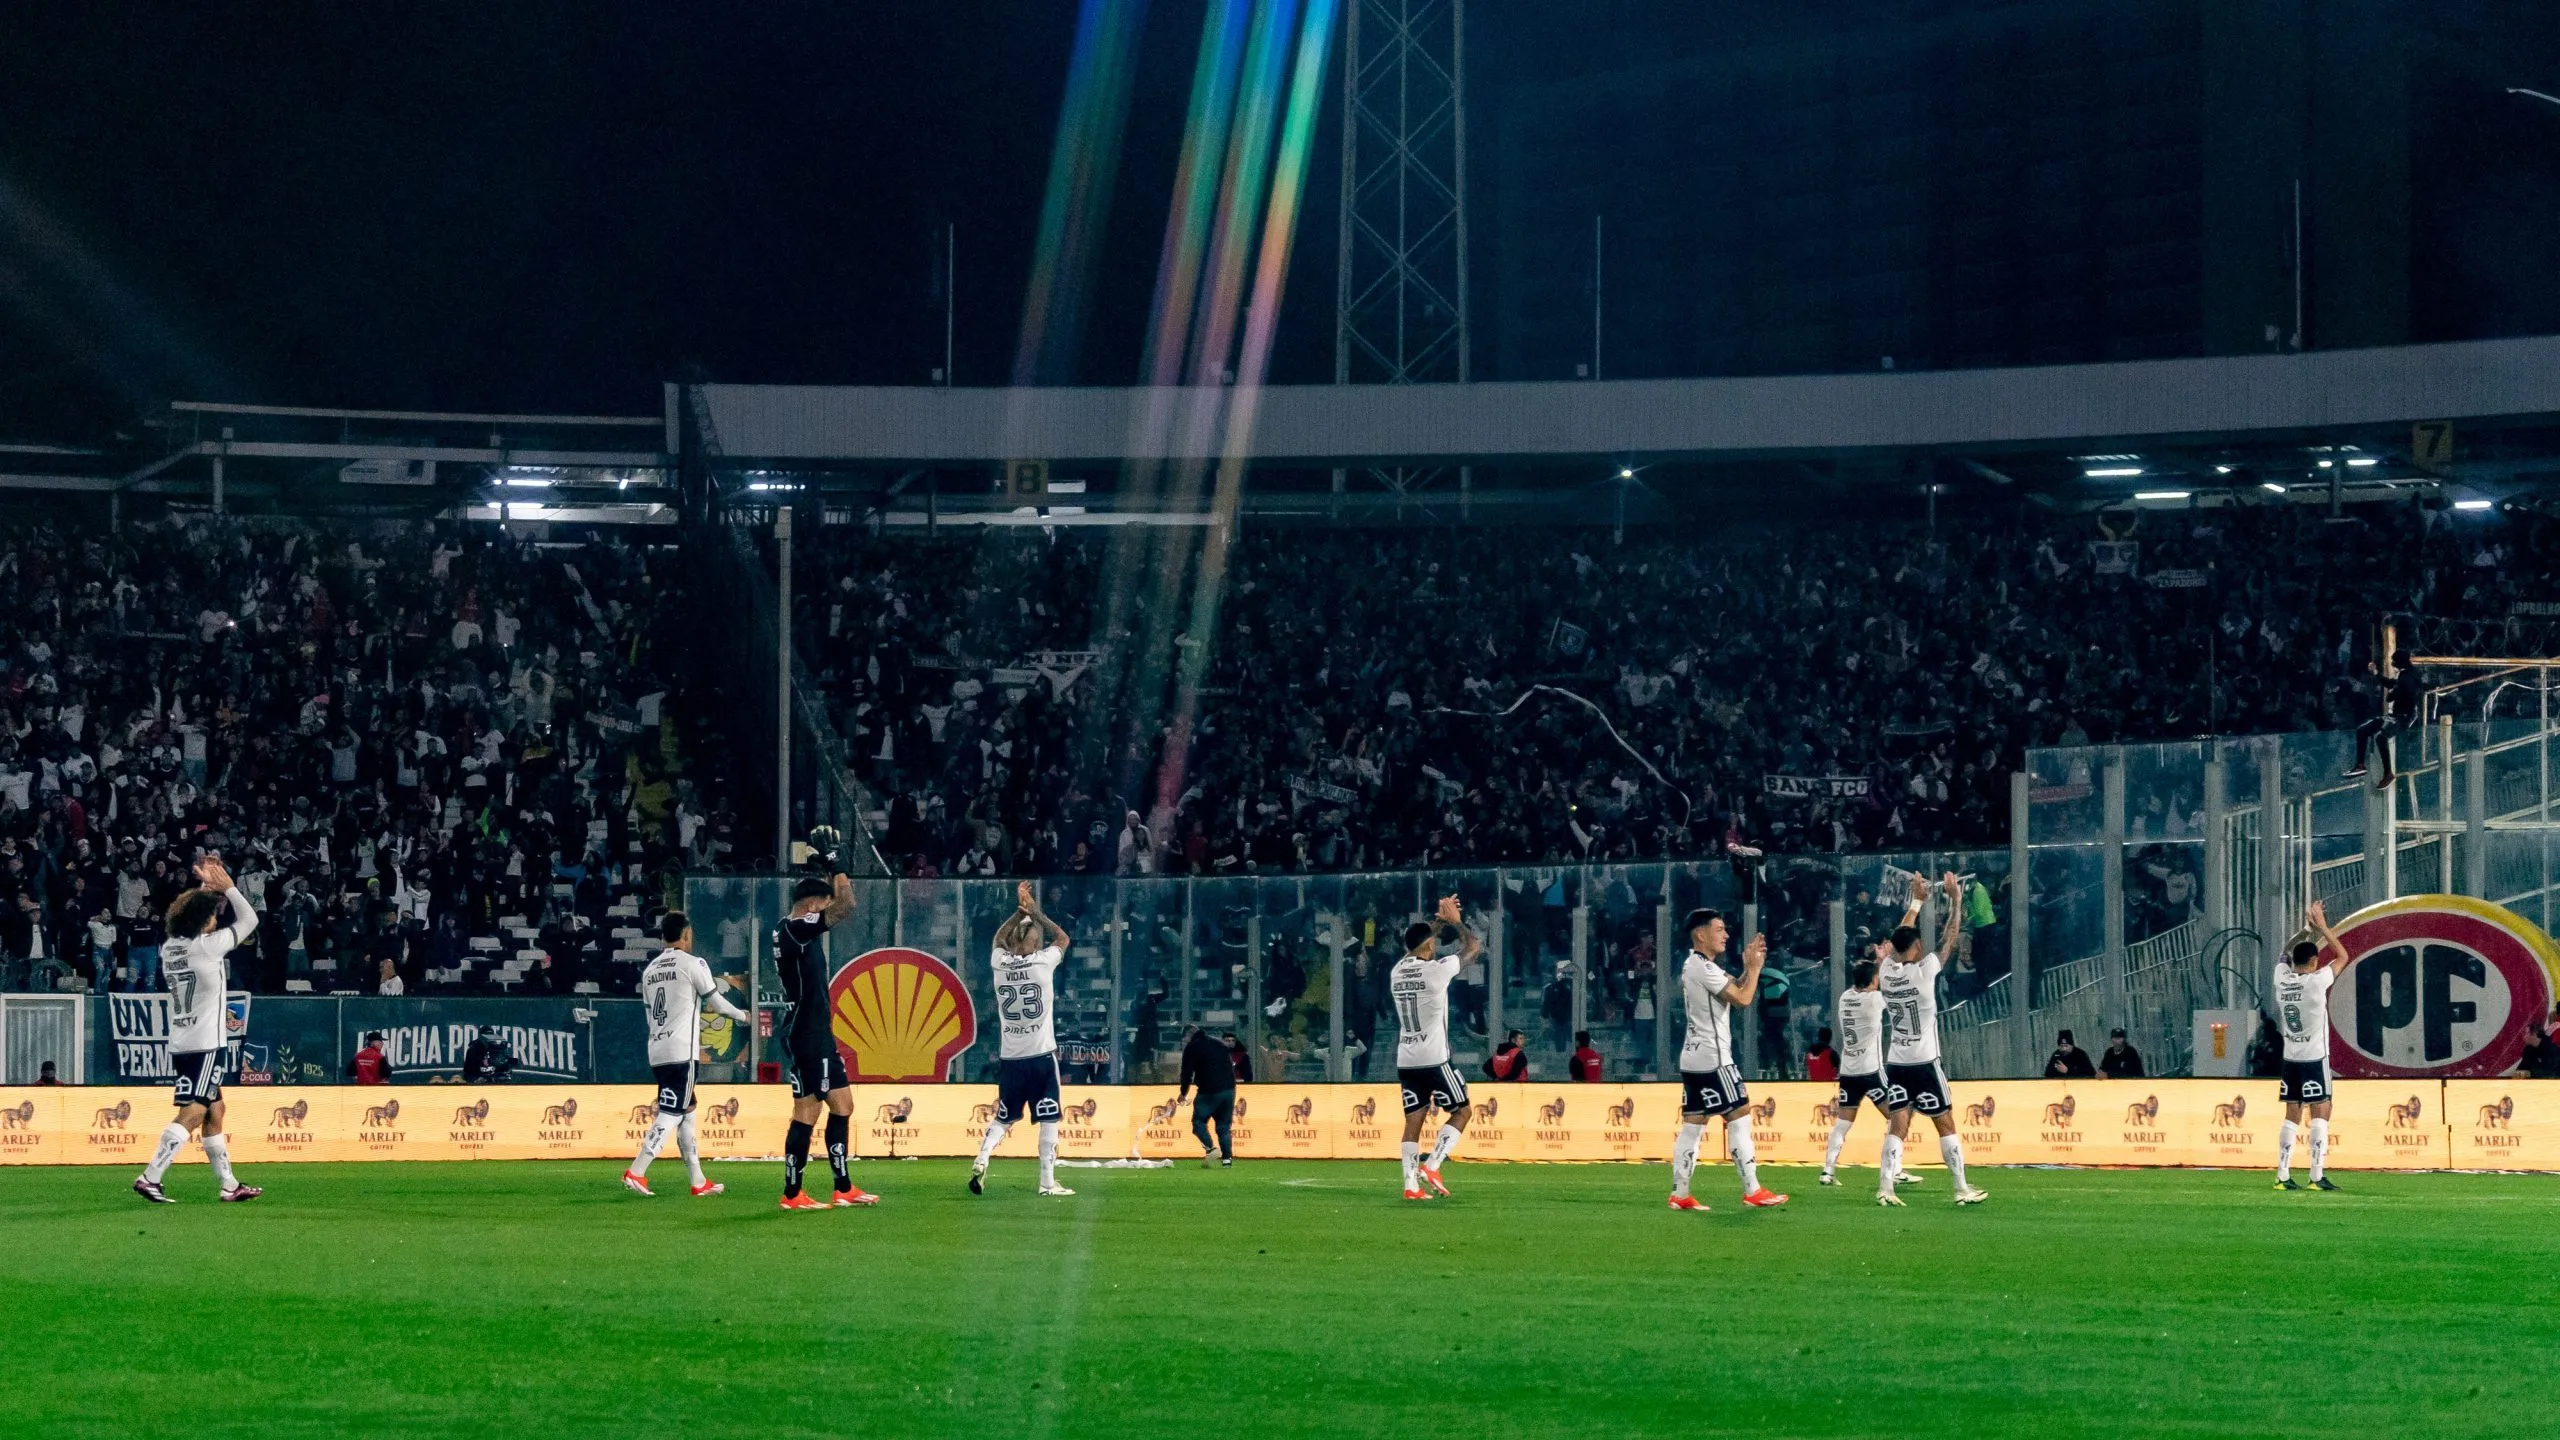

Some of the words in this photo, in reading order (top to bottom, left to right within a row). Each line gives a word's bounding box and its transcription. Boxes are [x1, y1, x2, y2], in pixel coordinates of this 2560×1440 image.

[2421, 424, 2446, 458] 7
[647, 971, 677, 985] SALDIVIA
[1005, 970, 1030, 981] VIDAL
[998, 983, 1044, 1020] 23
[2355, 944, 2487, 1062] PF
[653, 987, 668, 1027] 4
[1888, 1000, 1921, 1036] 21
[2283, 1004, 2303, 1033] 8
[303, 1063, 325, 1077] 1925
[822, 1058, 829, 1078] 1
[266, 1133, 314, 1143] MARLEY
[358, 1132, 406, 1142] MARLEY
[449, 1131, 496, 1141] MARLEY
[538, 1130, 584, 1140] MARLEY
[701, 1129, 746, 1139] MARLEY
[872, 1129, 920, 1138] MARLEY
[1057, 1129, 1104, 1139] MARLEY
[1145, 1130, 1184, 1139] MARLEY
[1284, 1130, 1318, 1139] MARLEY
[1349, 1130, 1383, 1139] MARLEY
[1470, 1130, 1504, 1140] MARLEY
[1536, 1131, 1571, 1141] MARLEY
[1604, 1132, 1641, 1142] MARLEY
[1750, 1132, 1782, 1142] ARLEY
[1961, 1132, 2002, 1143] MARLEY
[2040, 1132, 2083, 1142] MARLEY
[2123, 1132, 2167, 1143] MARLEY
[2209, 1133, 2254, 1144] MARLEY
[1, 1135, 41, 1145] ARLEY
[88, 1134, 138, 1144] MARLEY
[2383, 1135, 2430, 1146] MARLEY
[2474, 1136, 2522, 1147] MARLEY
